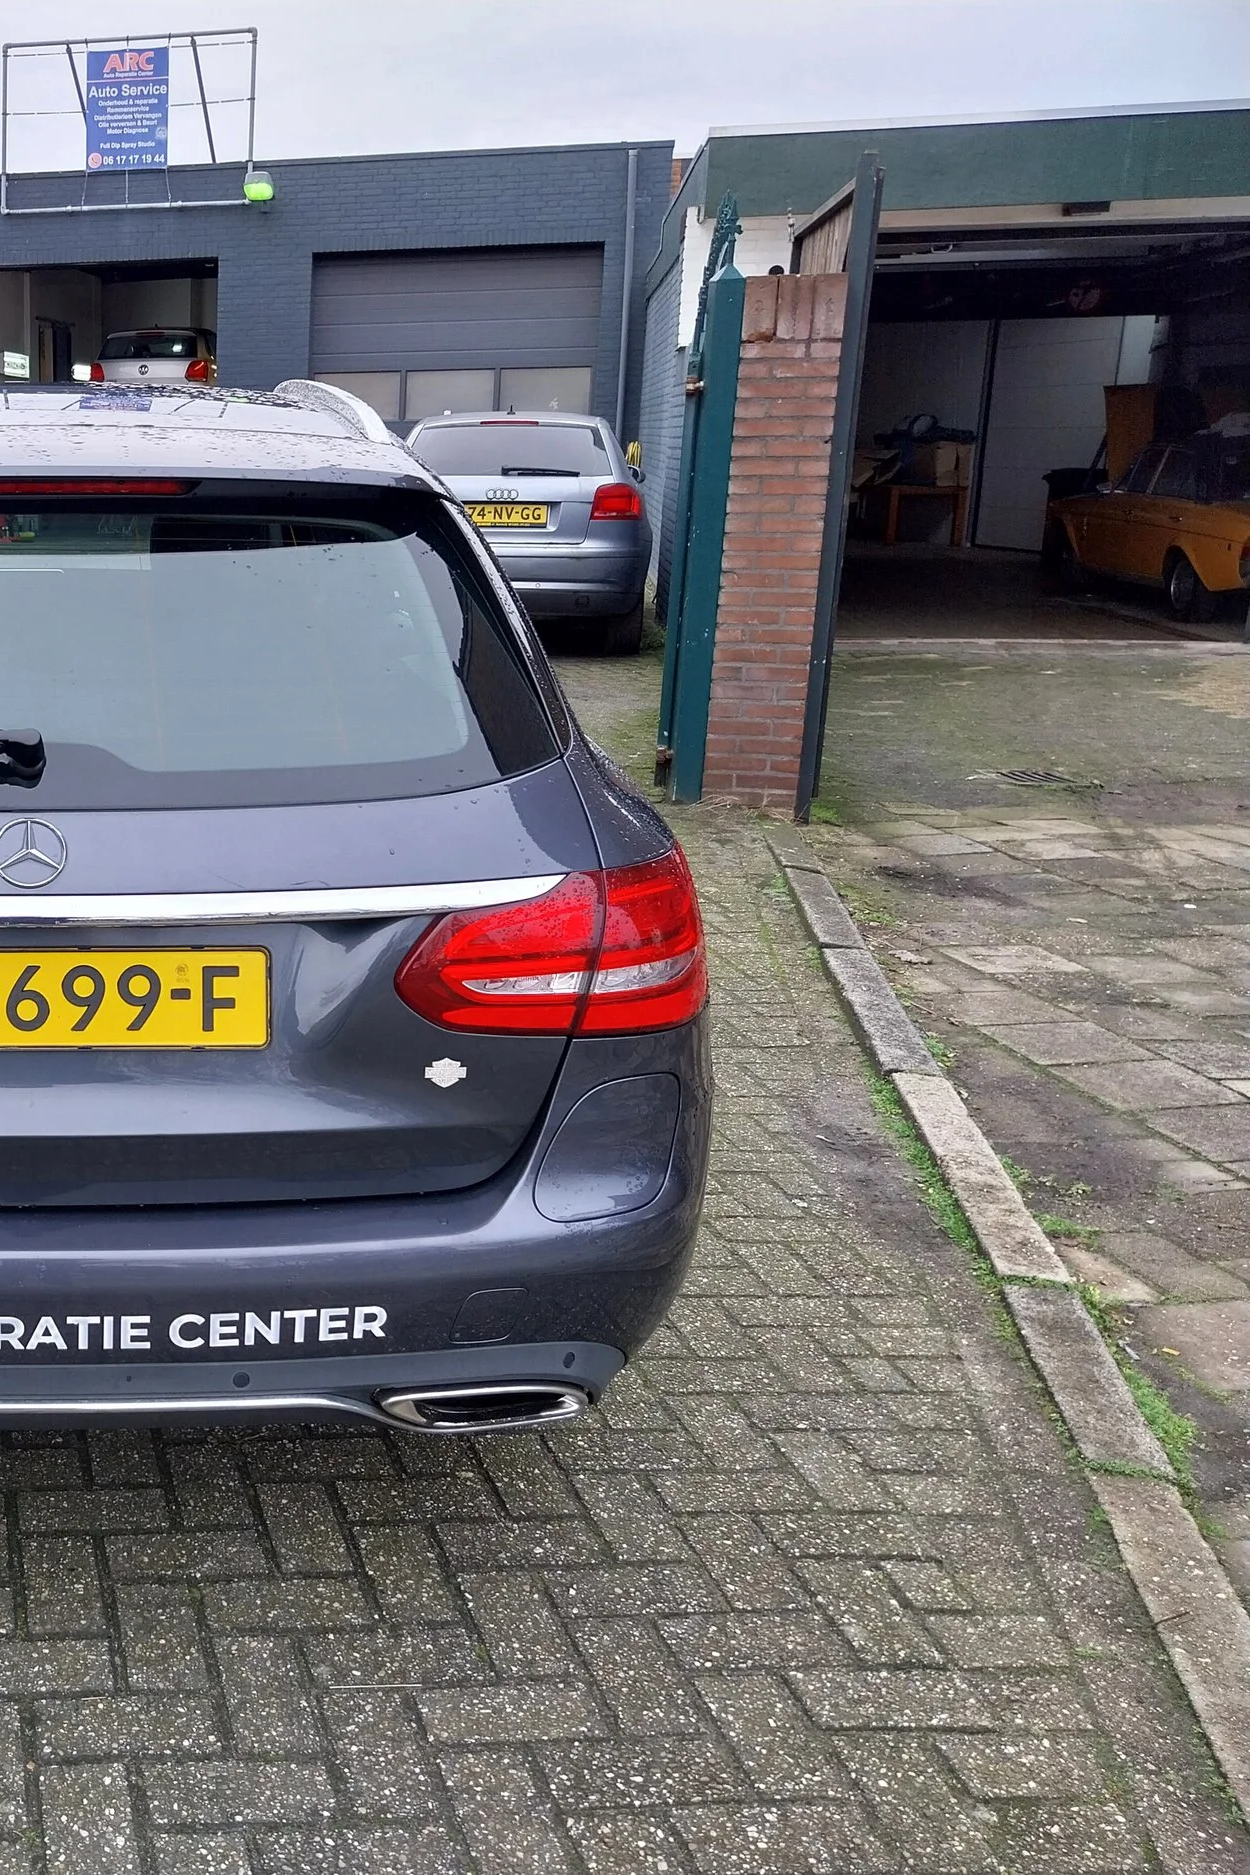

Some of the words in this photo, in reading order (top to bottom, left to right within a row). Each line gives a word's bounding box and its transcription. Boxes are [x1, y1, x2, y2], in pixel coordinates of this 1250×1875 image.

[103, 51, 154, 72] ARC
[89, 86, 119, 98] Auto
[121, 83, 167, 96] Service
[98, 99, 128, 107] Onderhoud
[135, 98, 159, 106] reparatie
[134, 112, 162, 121] Vervangen
[124, 128, 149, 136] Diagnose
[112, 142, 121, 150] Dip
[122, 141, 137, 150] Spray
[138, 140, 156, 148] Studio
[103, 155, 114, 165] 06
[116, 155, 126, 165] 17
[129, 155, 140, 164] 17
[142, 154, 152, 164] 19
[153, 154, 165, 164] 44
[468, 506, 542, 521] 74-NV-GG
[168, 1305, 390, 1351] CENTER
